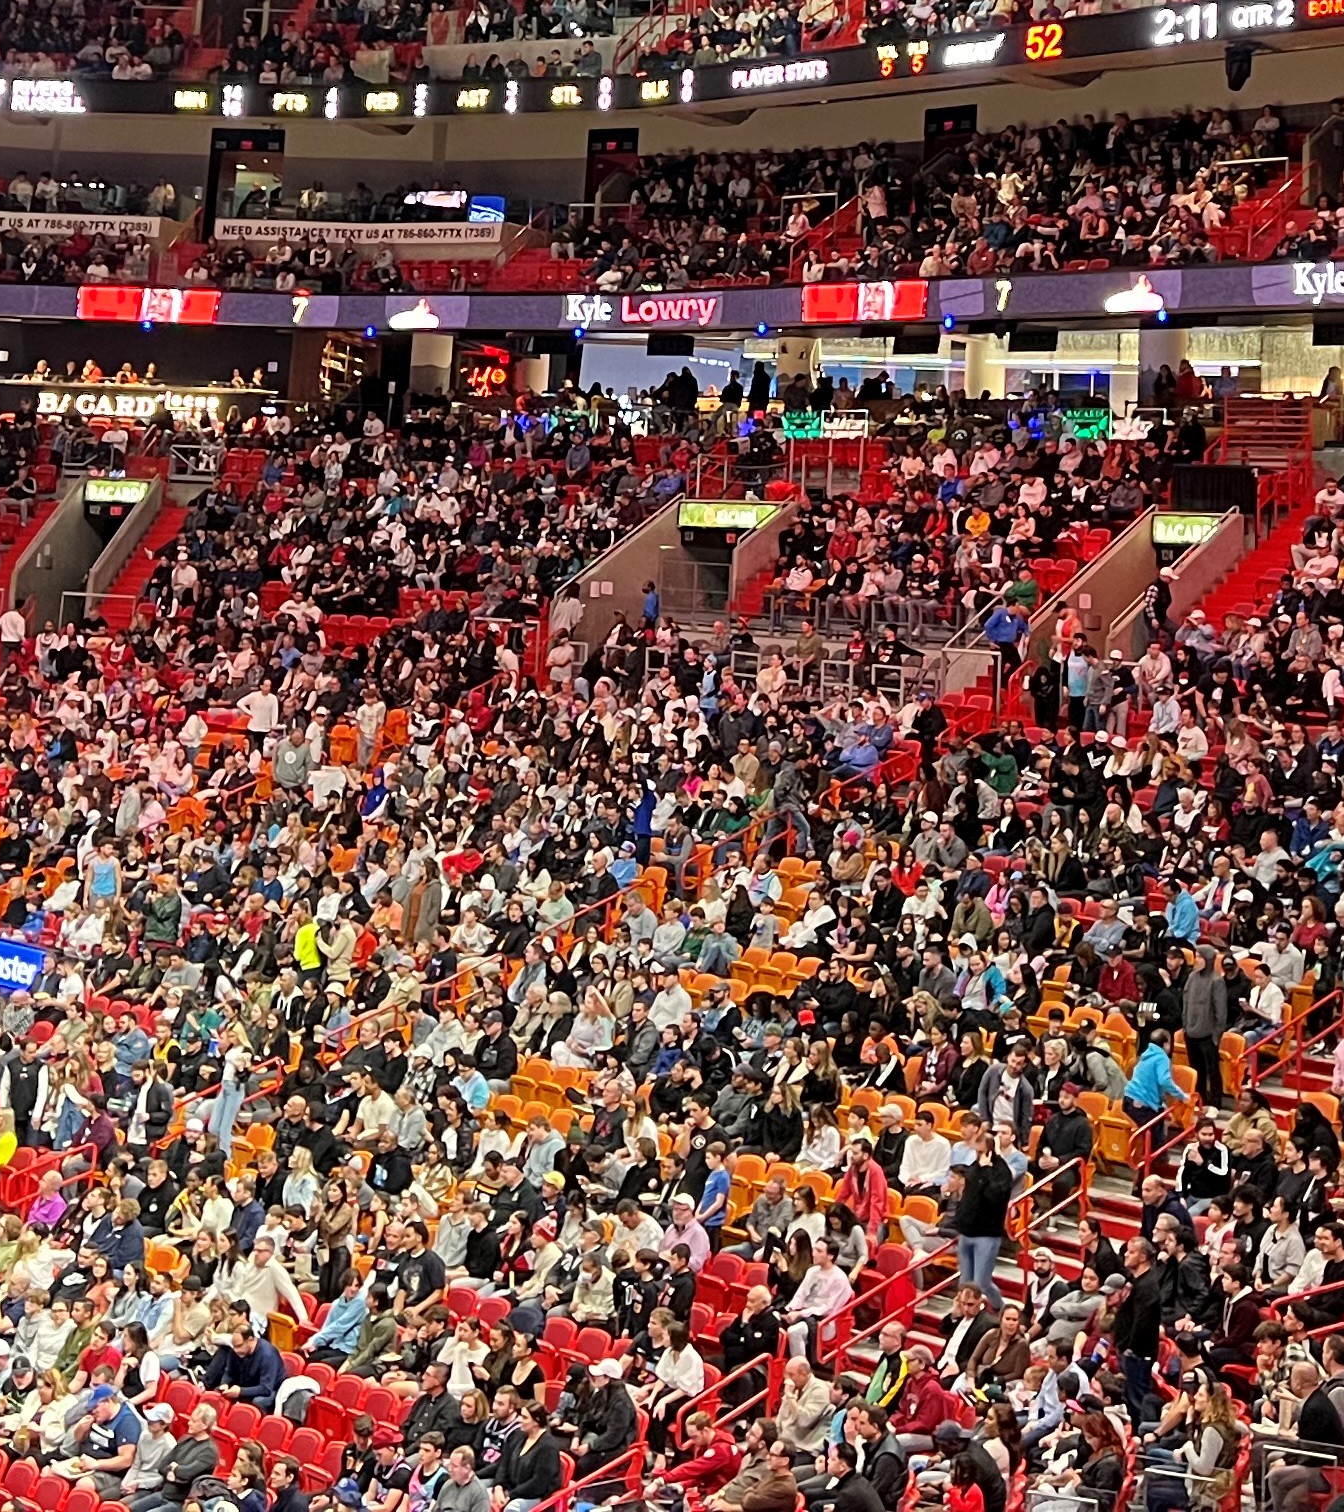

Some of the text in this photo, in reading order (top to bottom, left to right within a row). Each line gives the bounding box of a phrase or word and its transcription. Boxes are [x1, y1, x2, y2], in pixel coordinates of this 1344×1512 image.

[1154, 2, 1218, 45] 2:11
[1231, 3, 1274, 29] QTR
[1025, 24, 1064, 60] 52
[731, 59, 829, 89] PLAYER STATS
[8, 217, 24, 228] US
[26, 218, 41, 229] AT
[222, 225, 252, 236] NEED
[256, 226, 330, 239] ASSISTANCE?
[334, 228, 363, 239] TEXT
[365, 228, 379, 239] US
[381, 229, 396, 239] AT
[292, 296, 309, 324] 7
[996, 280, 1012, 311] 7
[566, 294, 717, 329] Kyle Lowry
[36, 391, 156, 418] BCARD
